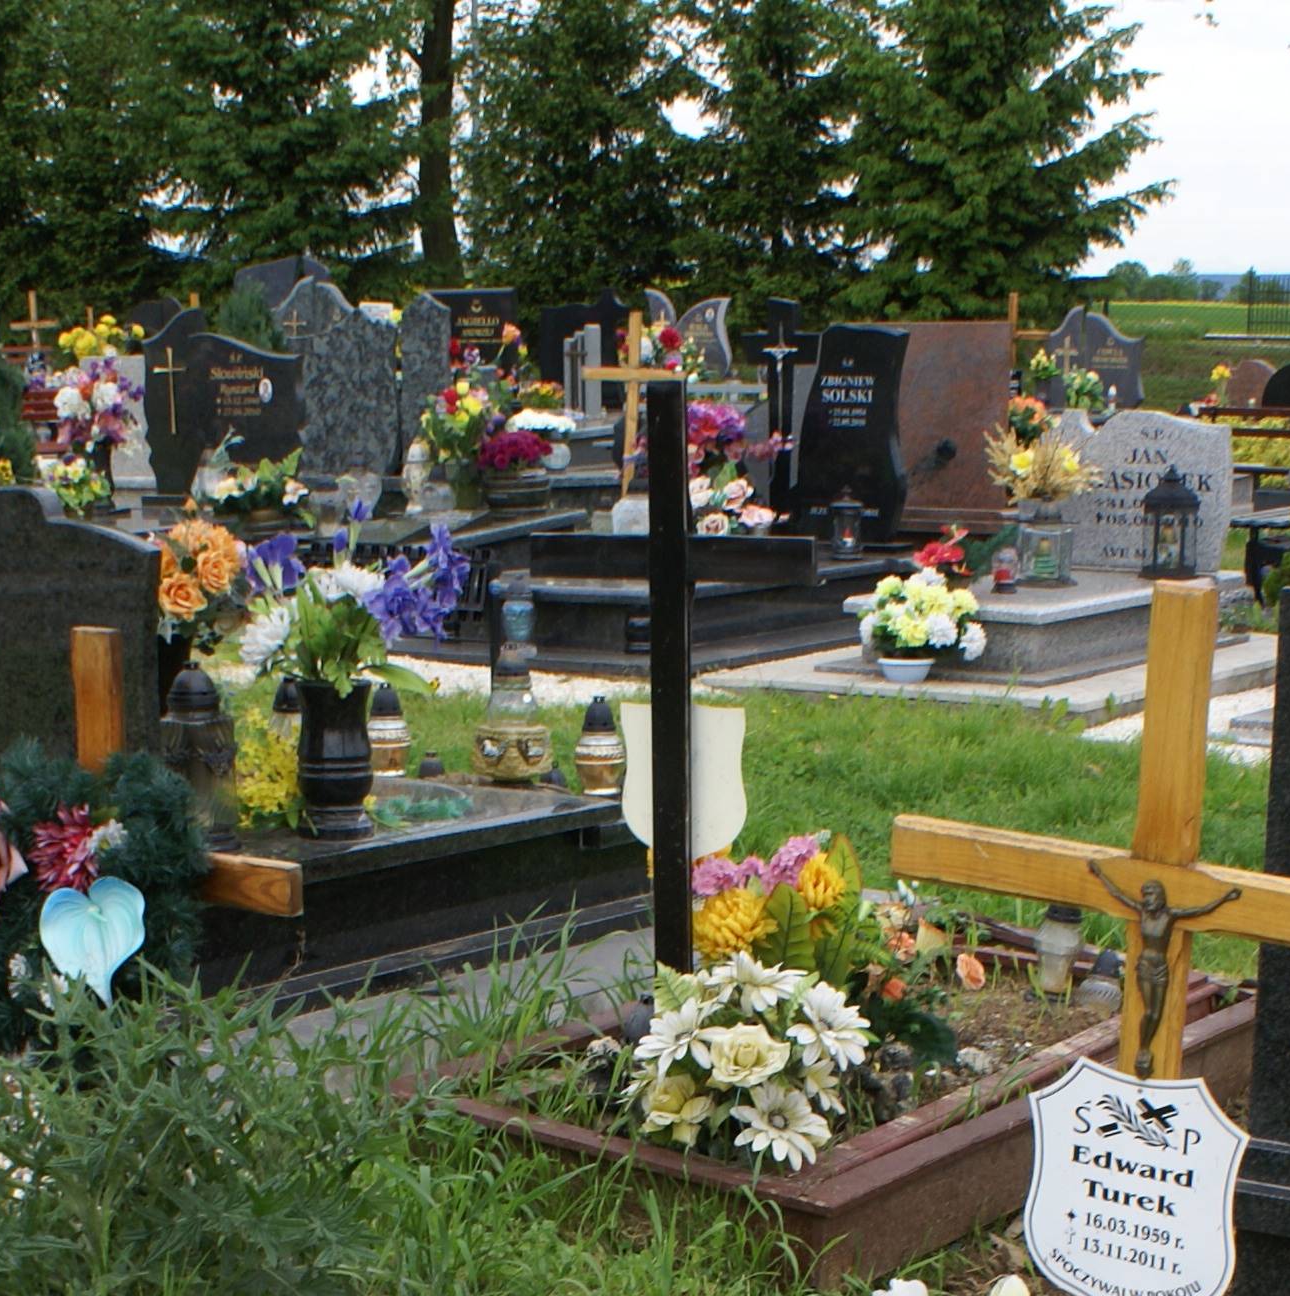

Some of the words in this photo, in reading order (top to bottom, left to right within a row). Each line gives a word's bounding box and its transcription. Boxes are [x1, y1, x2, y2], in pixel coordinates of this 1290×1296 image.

[820, 374, 877, 386] ZBIGNIEW
[821, 388, 874, 403] SOLSKI
[1124, 447, 1170, 465] JAN
[1182, 1128, 1202, 1156] P
[1071, 1143, 1195, 1189] Edward
[1082, 1177, 1178, 1218] Turek
[1084, 1211, 1171, 1246] 16.03.1959
[1082, 1236, 1167, 1272] 13.11.2011
